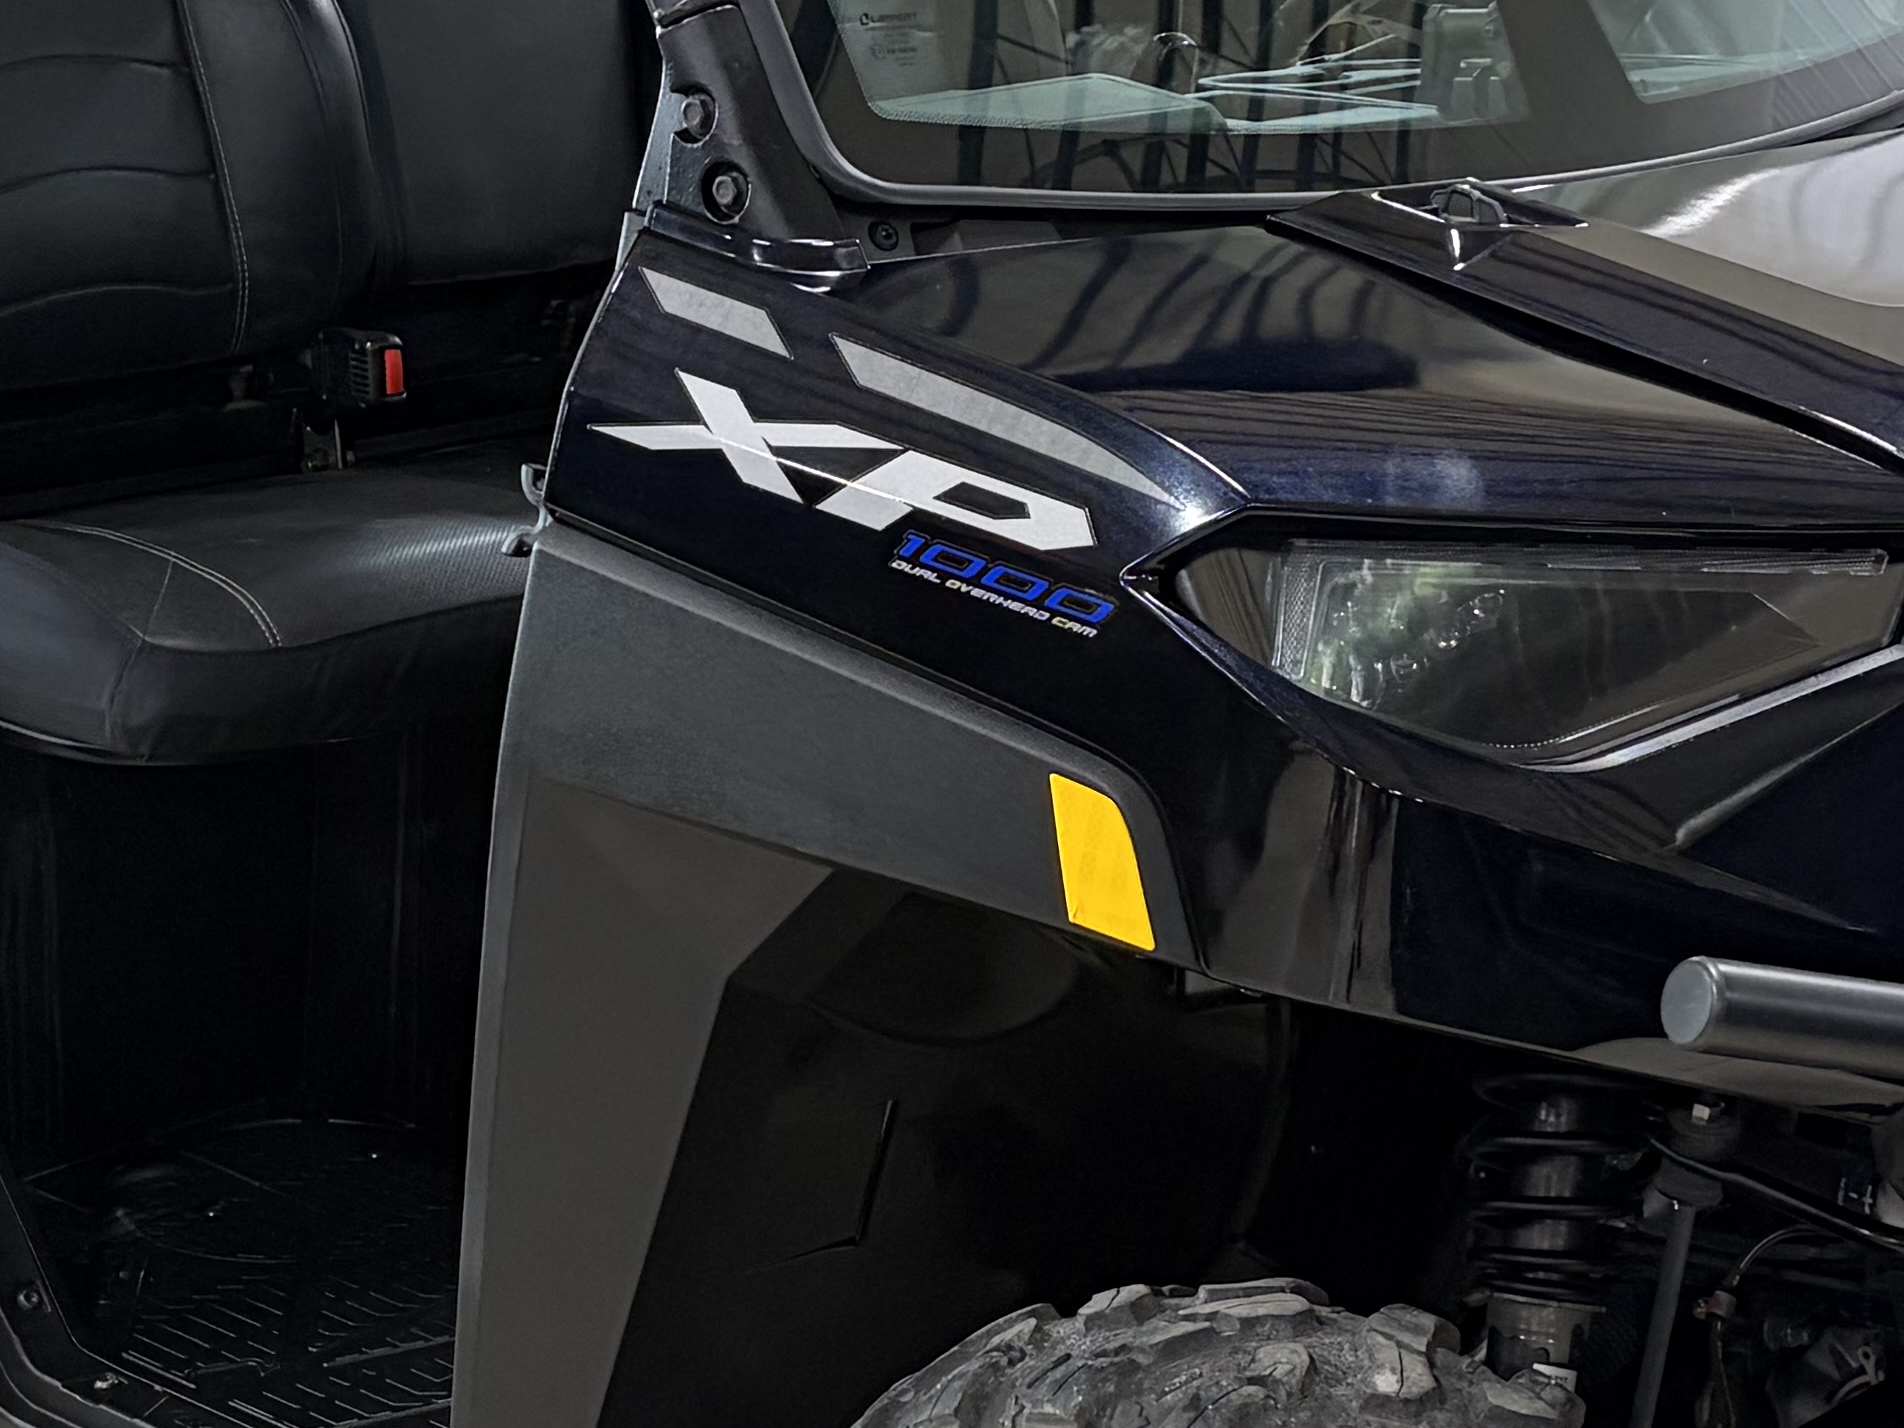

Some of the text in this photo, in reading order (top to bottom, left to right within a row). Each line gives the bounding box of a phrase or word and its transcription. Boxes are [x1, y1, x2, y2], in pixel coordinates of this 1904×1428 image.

[587, 368, 1098, 551] XP
[891, 559, 1098, 638] DUAL OVERHEAD CAM
[896, 531, 1118, 625] 1000
